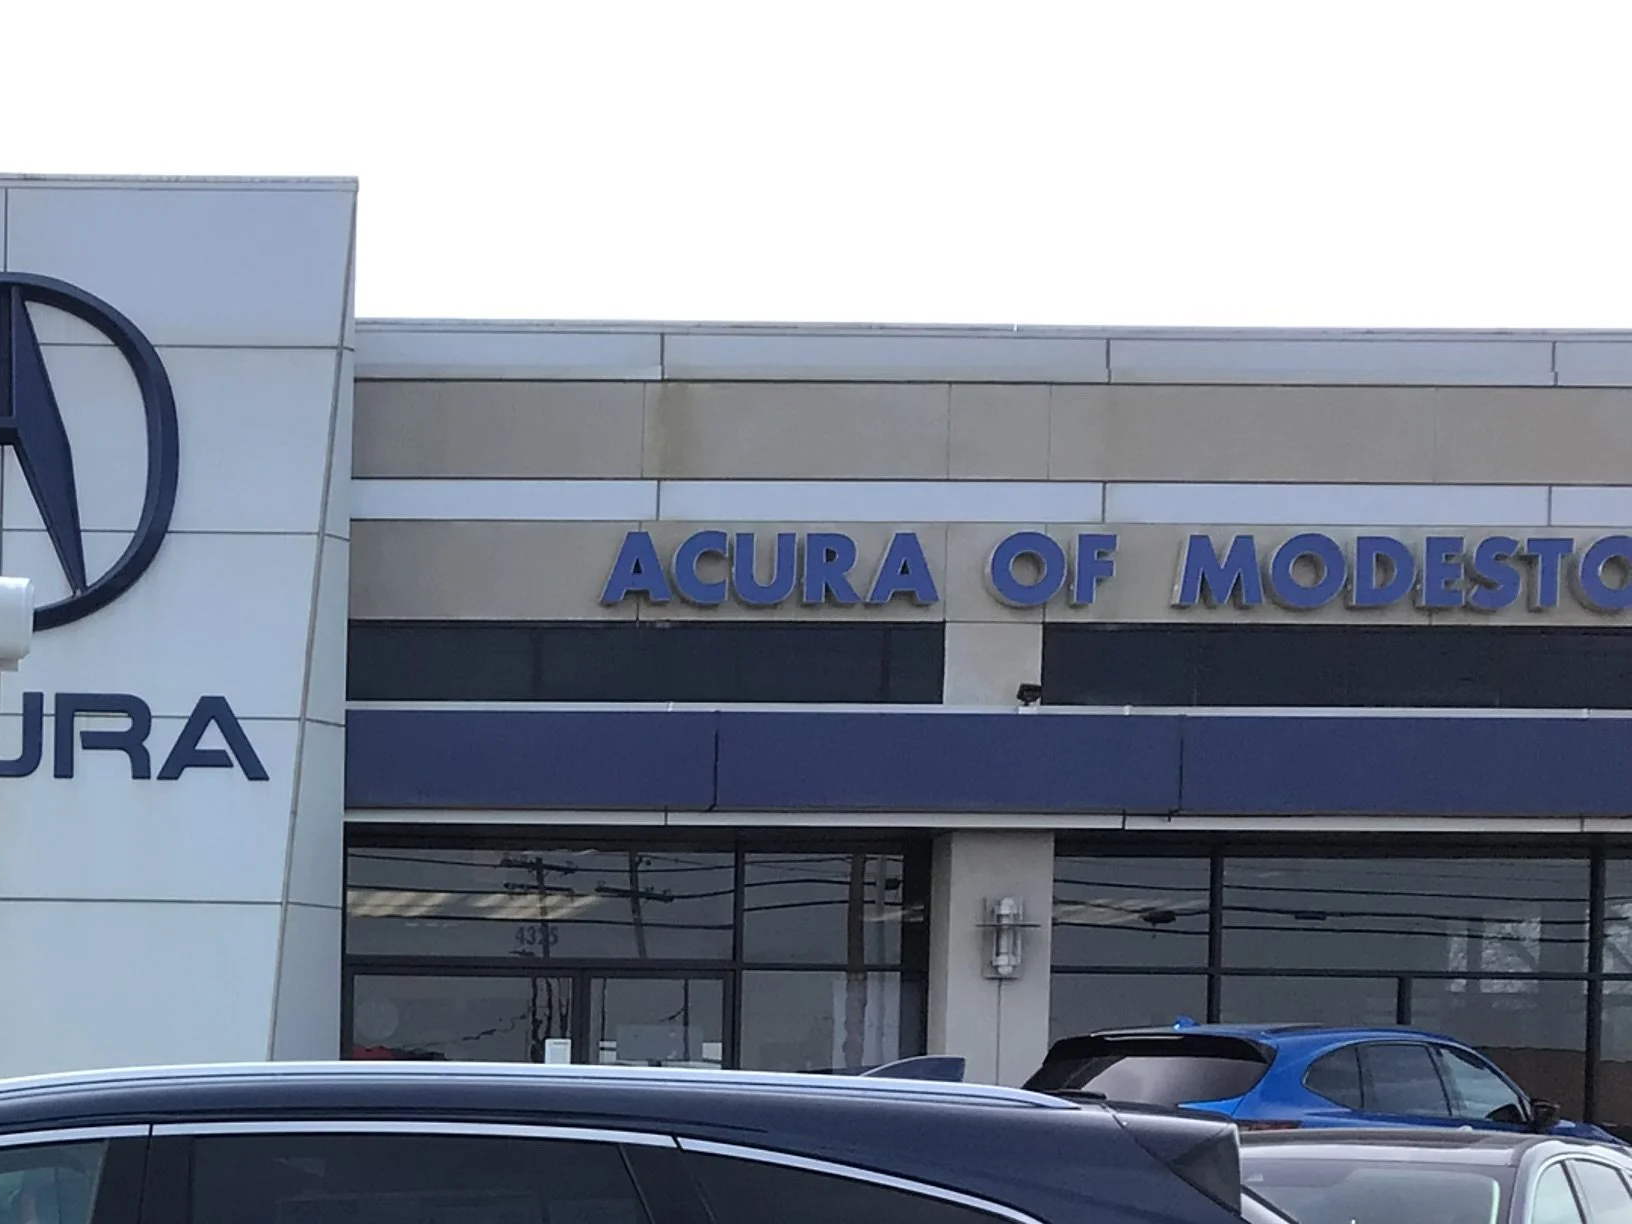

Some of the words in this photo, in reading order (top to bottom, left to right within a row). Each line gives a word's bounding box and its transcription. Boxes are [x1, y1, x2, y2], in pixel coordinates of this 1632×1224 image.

[600, 529, 940, 607] ACURA
[985, 530, 1118, 607] OF
[1172, 533, 1632, 611] MODESTO
